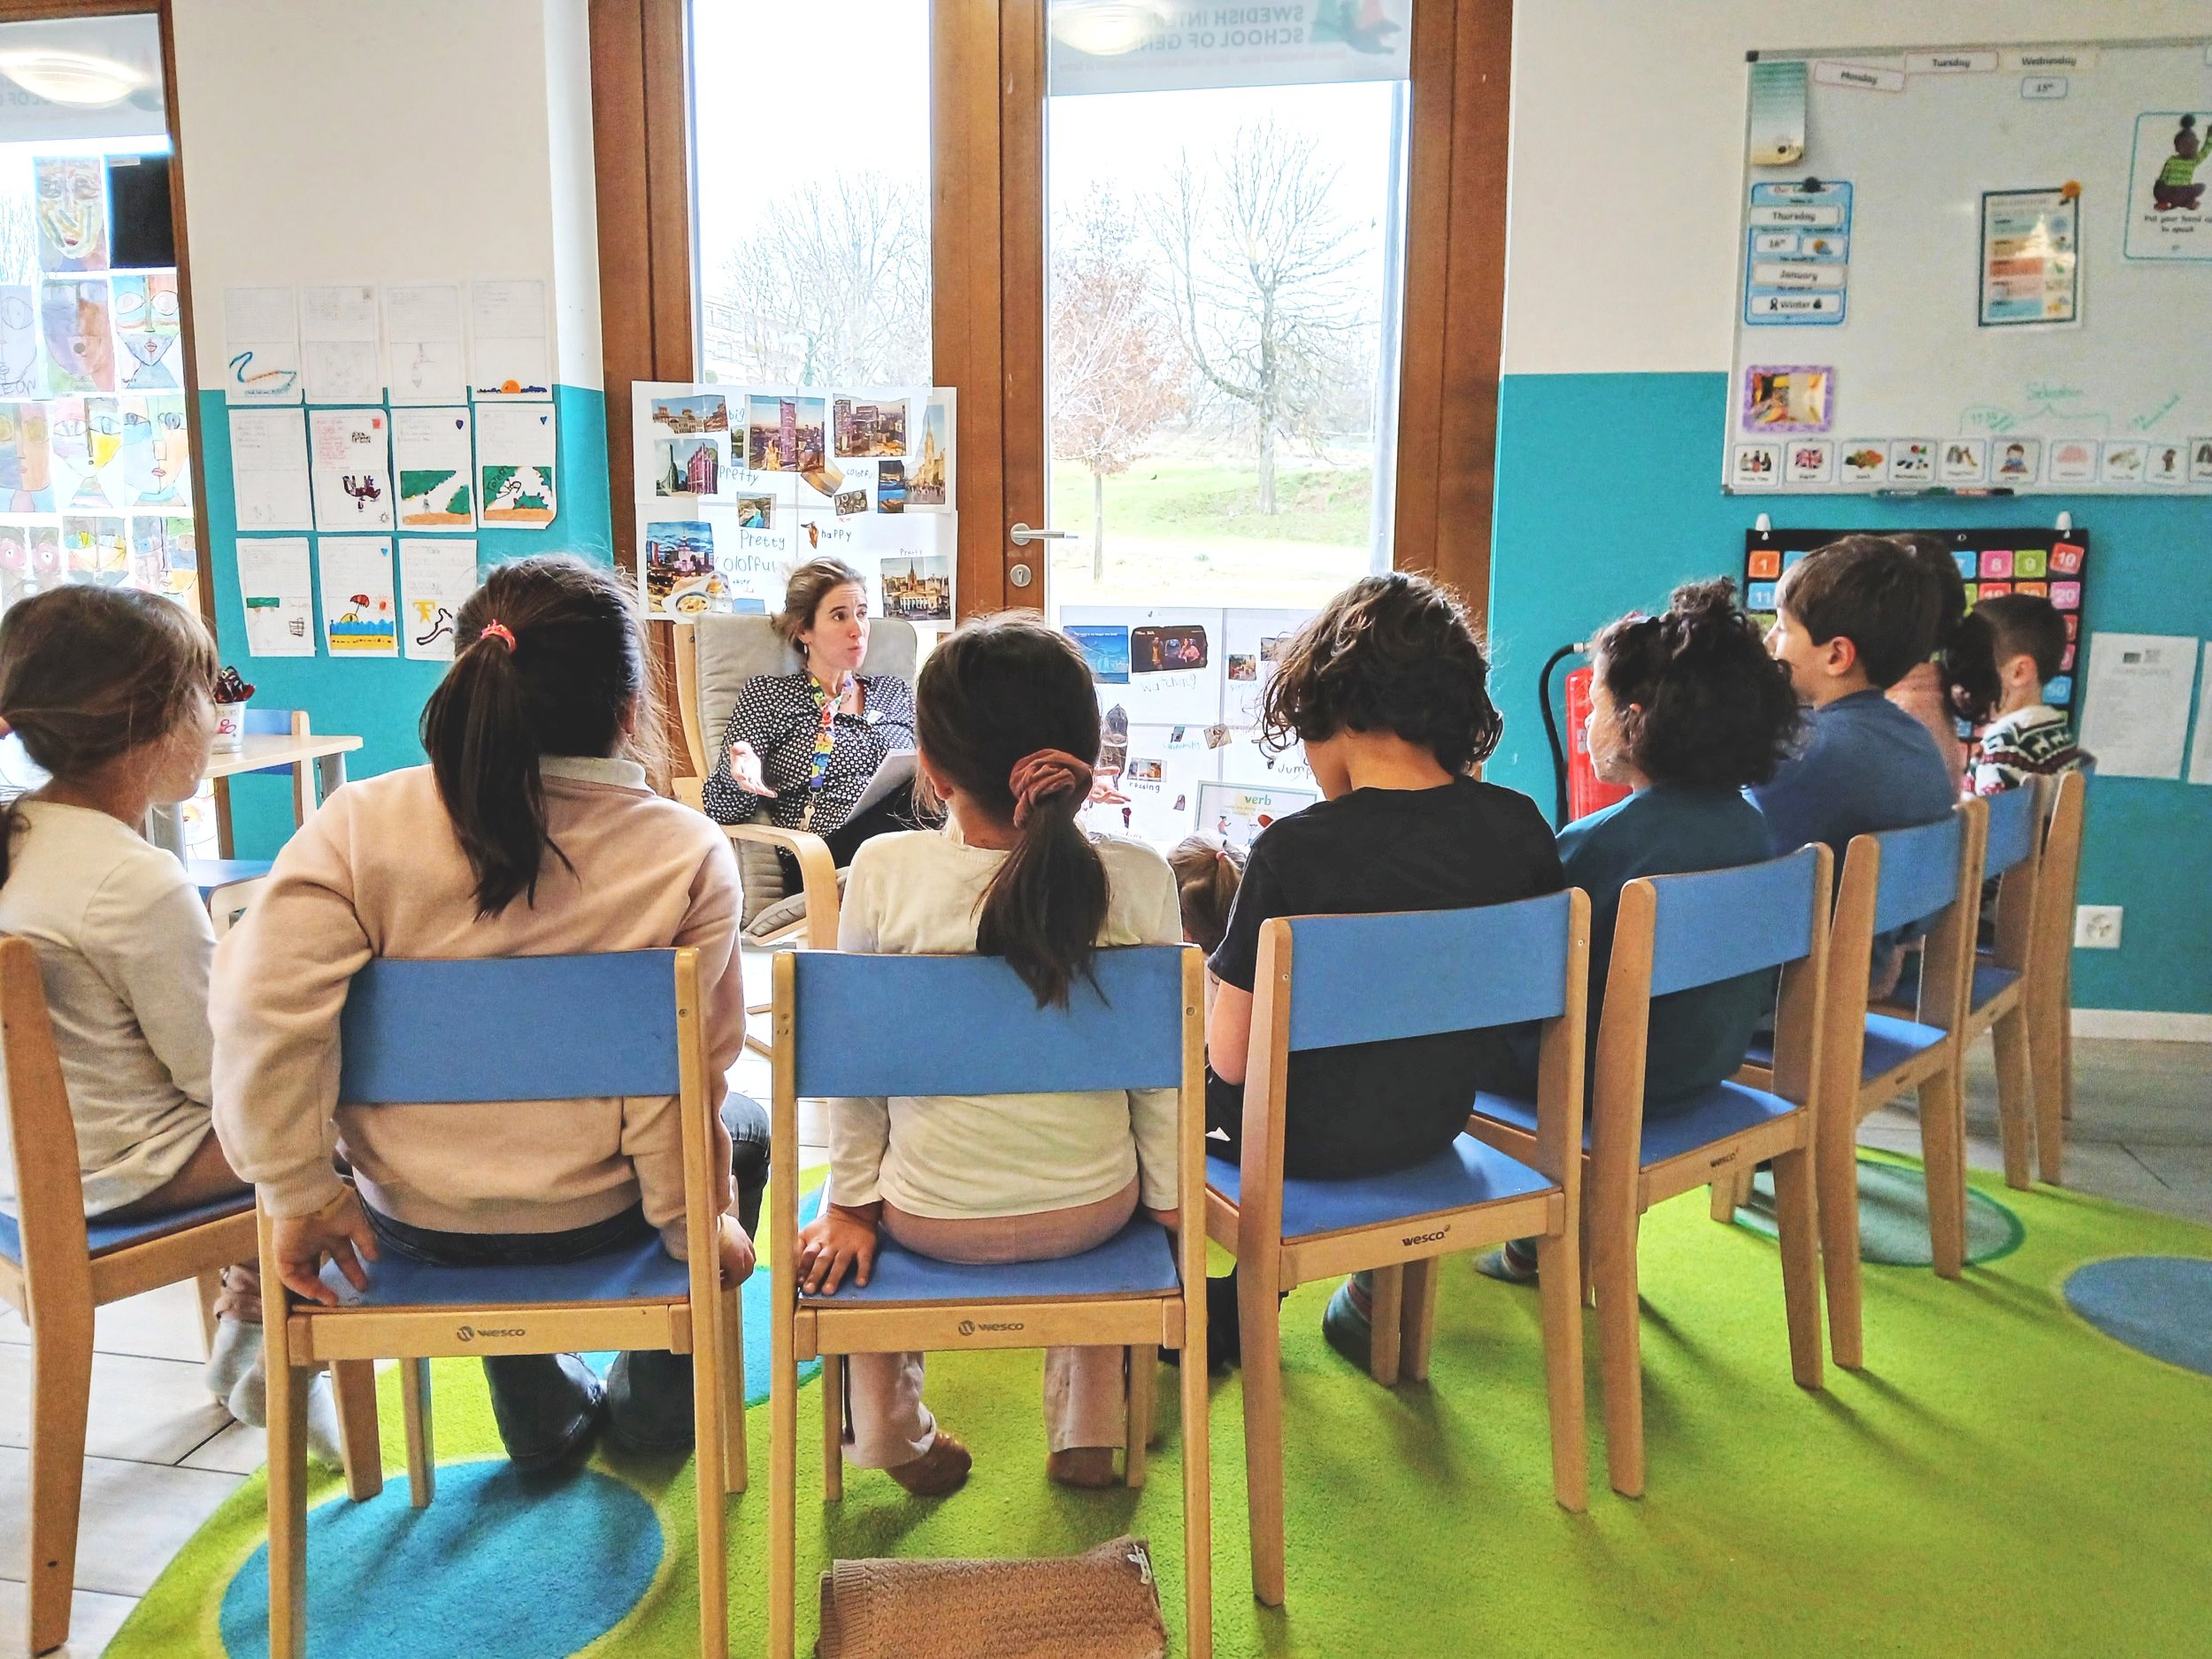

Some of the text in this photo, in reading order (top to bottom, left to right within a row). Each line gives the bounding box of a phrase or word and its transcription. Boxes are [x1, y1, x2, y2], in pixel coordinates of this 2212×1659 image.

[1932, 58, 1970, 69] Tuesday
[1773, 211, 1816, 222] Thursday
[1779, 270, 1818, 281] January
[1780, 300, 1810, 309] Winter
[728, 408, 745, 423] big
[740, 528, 785, 550] Pretty
[2058, 552, 2077, 566] 10
[1759, 559, 1768, 571] 1
[1755, 592, 1770, 603] 11
[2053, 589, 2076, 603] 20
[1244, 795, 1271, 806] verb
